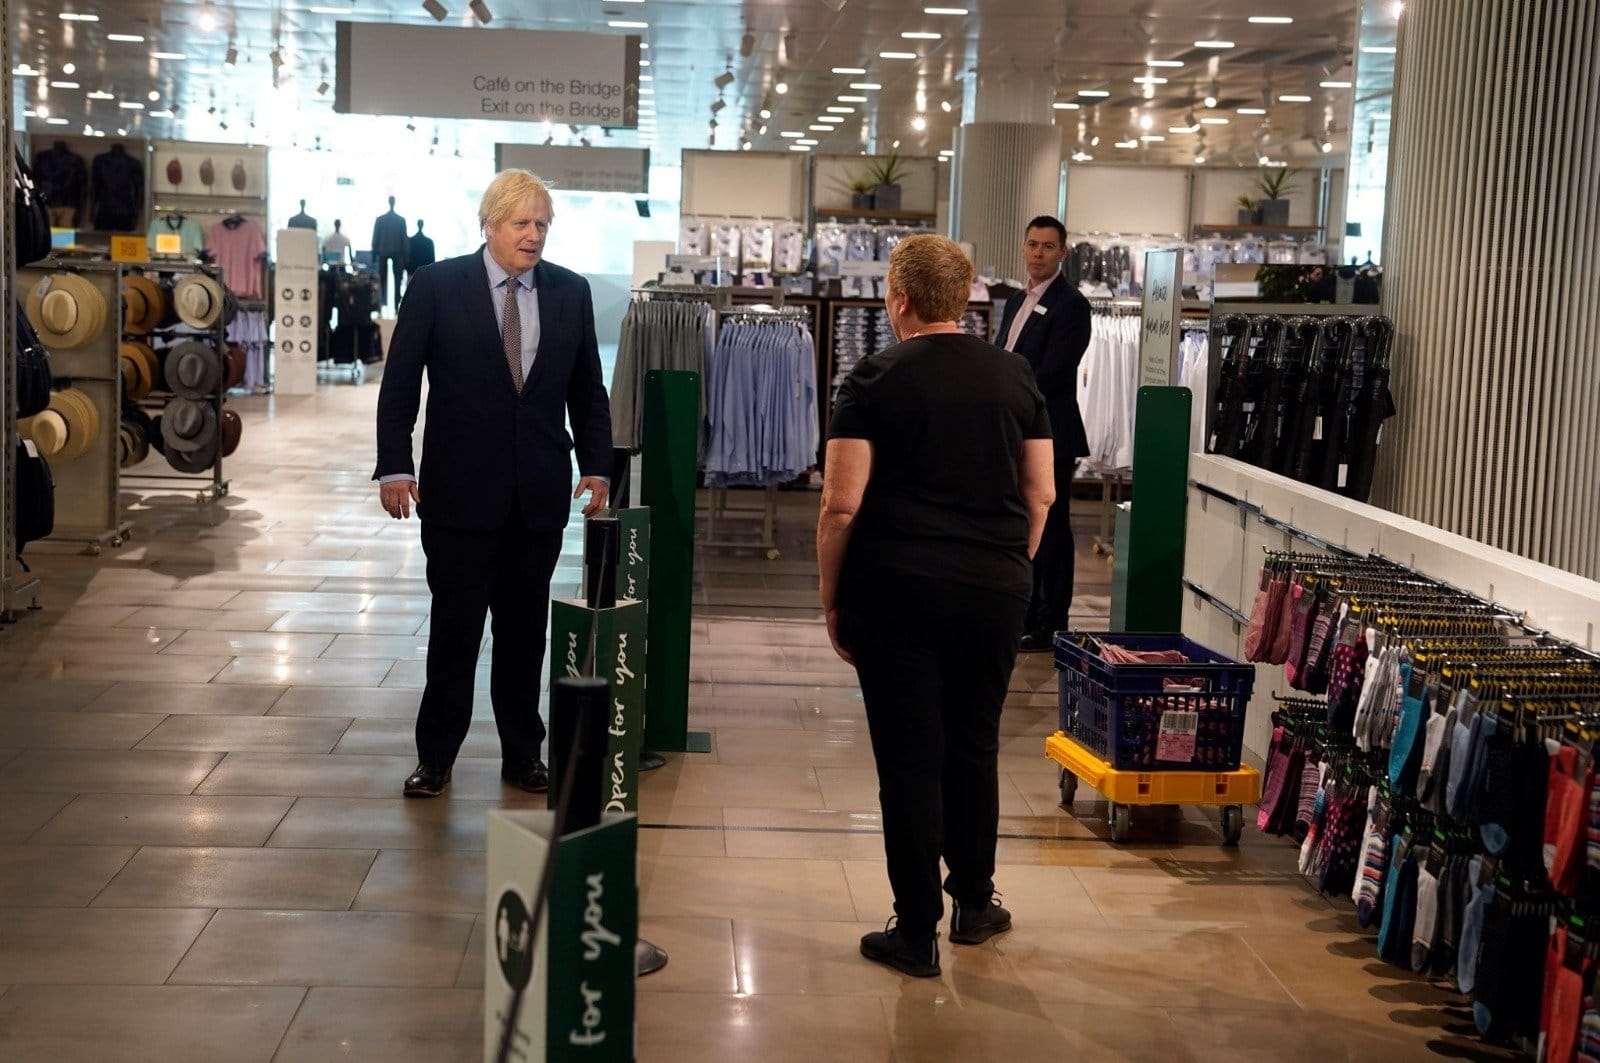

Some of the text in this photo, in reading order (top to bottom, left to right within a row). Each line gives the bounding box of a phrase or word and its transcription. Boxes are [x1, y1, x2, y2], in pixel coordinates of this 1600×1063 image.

[473, 75, 621, 99] Café on the Bridge
[481, 98, 621, 121] Exit on the Bridge
[623, 528, 643, 600] for you
[614, 632, 635, 685] you
[608, 698, 627, 738] for
[569, 872, 621, 1047] for you
